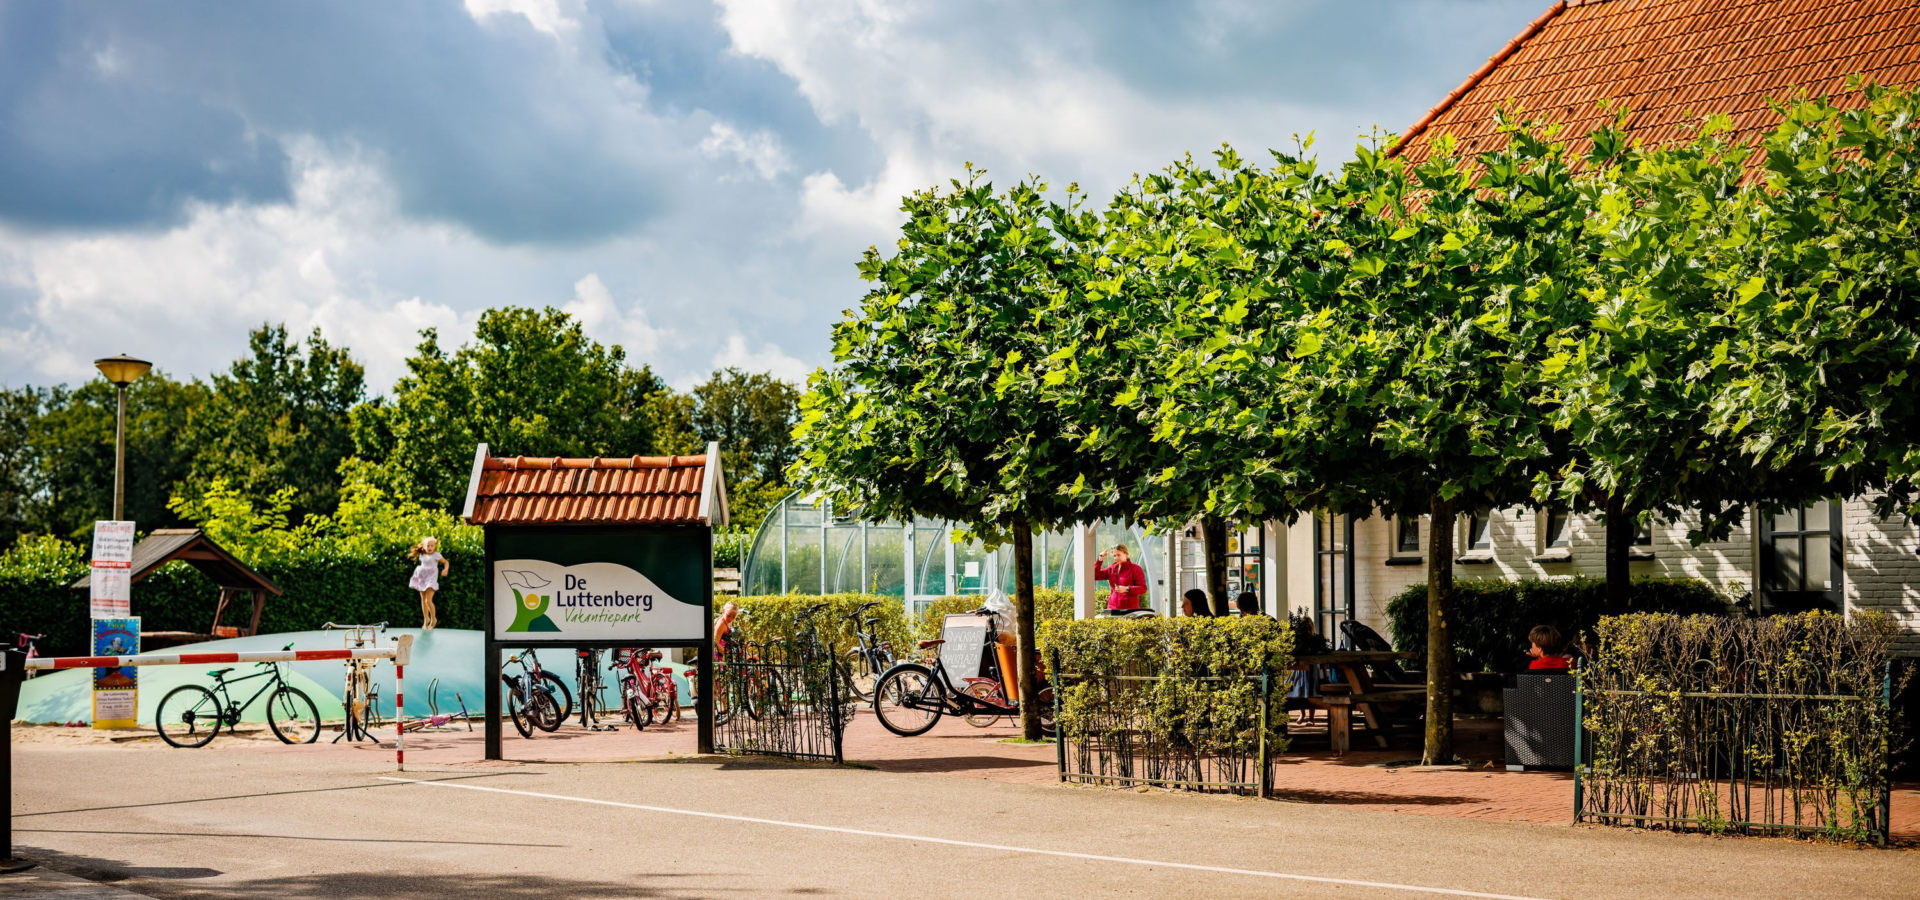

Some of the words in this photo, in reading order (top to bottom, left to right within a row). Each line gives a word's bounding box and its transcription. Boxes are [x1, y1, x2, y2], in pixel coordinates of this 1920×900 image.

[565, 574, 587, 591] De
[557, 590, 653, 612] Luttenberg
[565, 607, 642, 627] Vakantiepark
[947, 631, 982, 642] SNACKBAR
